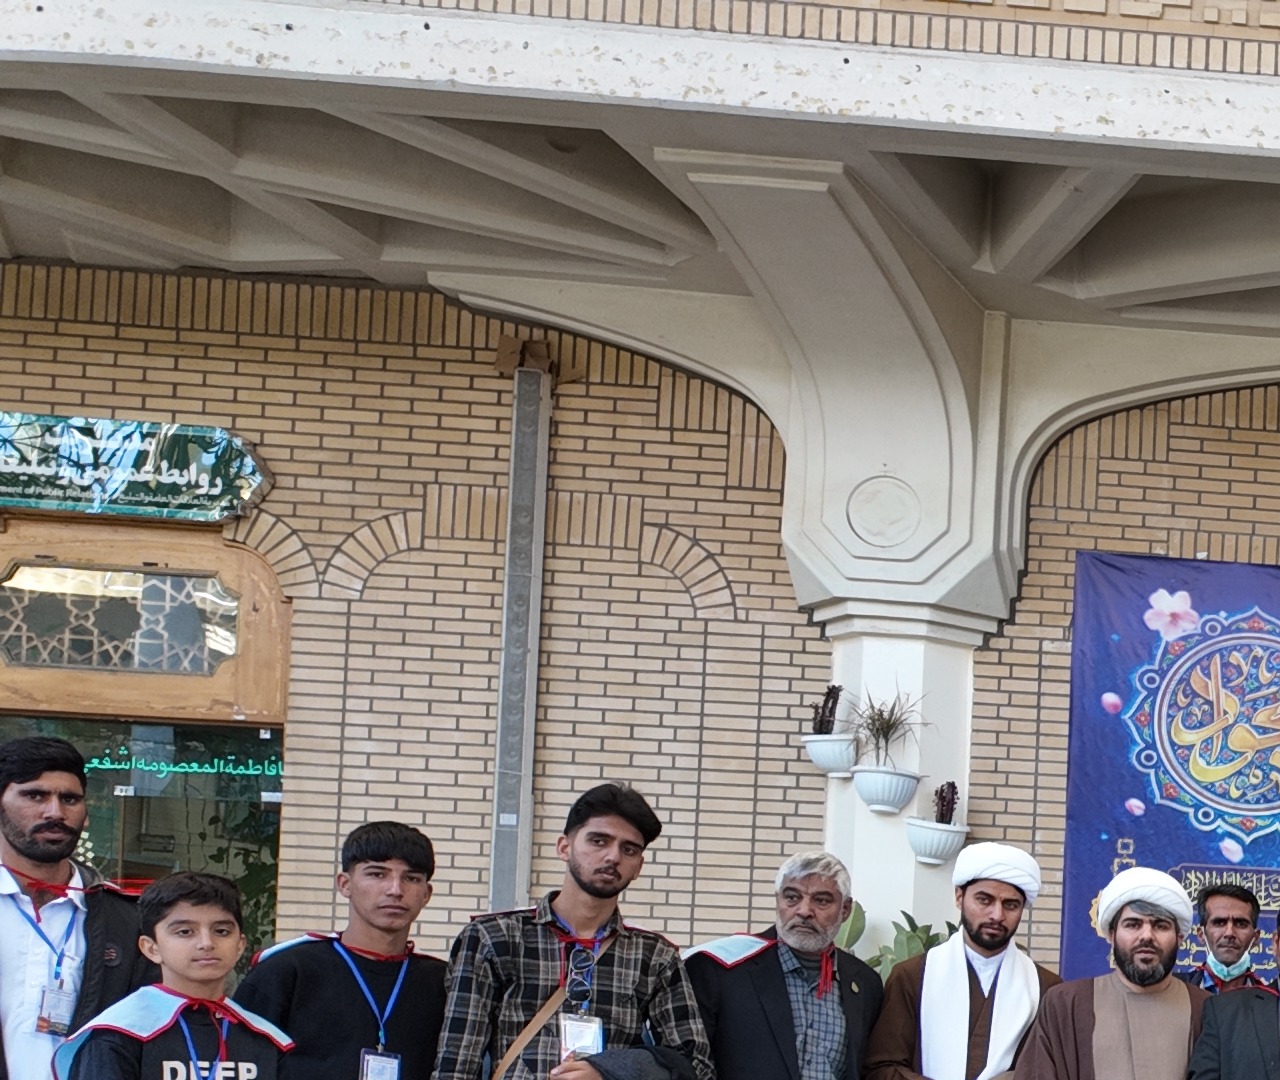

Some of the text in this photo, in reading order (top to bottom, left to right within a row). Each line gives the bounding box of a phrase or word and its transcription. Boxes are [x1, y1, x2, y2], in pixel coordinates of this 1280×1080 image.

[160, 460, 223, 495] روابط
[84, 745, 136, 775] اشفع
[224, 755, 277, 776] فاطمة
